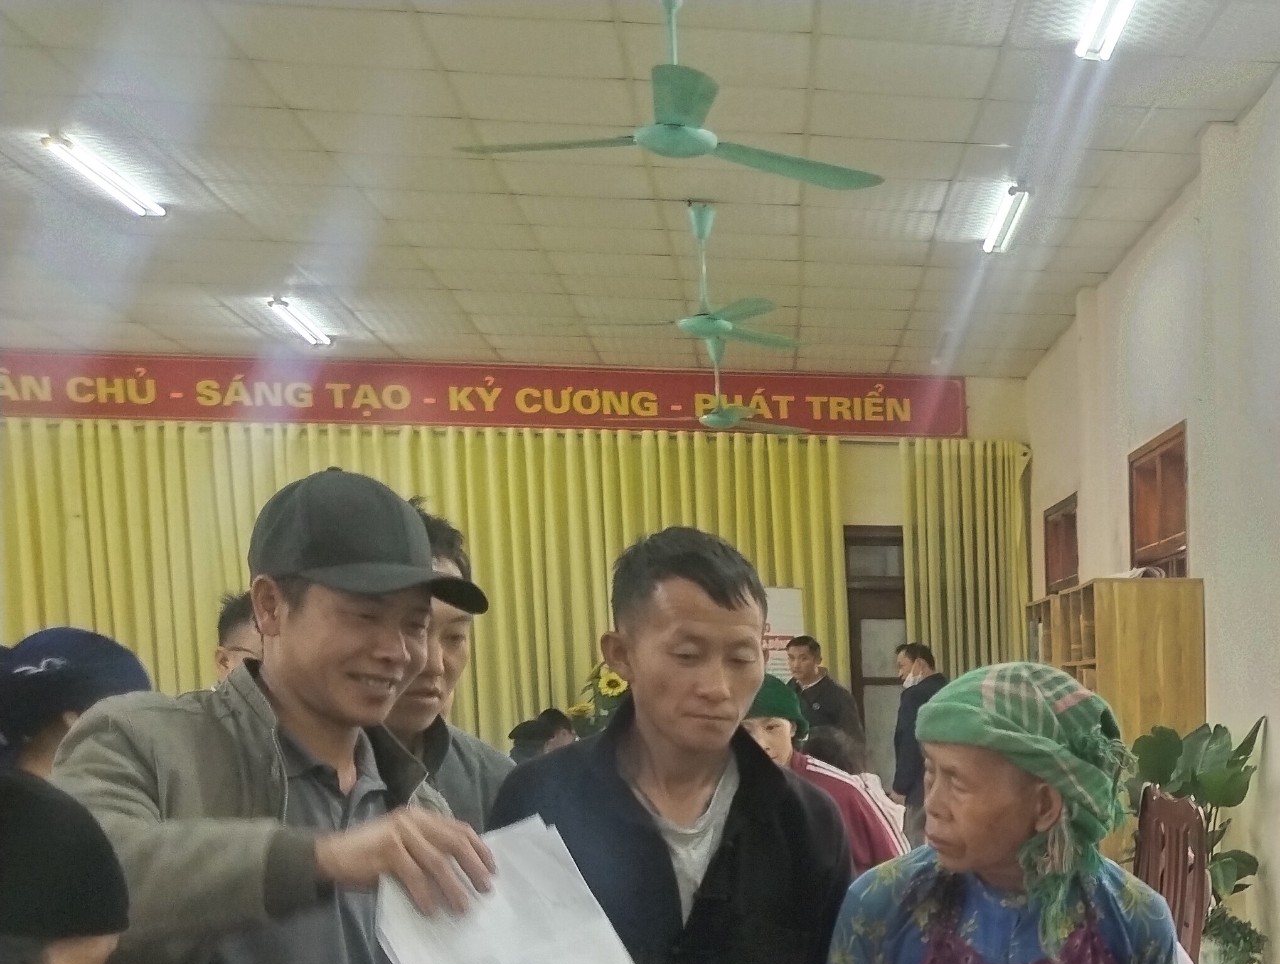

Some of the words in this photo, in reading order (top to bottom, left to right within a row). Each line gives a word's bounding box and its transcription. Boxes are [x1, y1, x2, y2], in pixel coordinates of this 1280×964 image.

[66, 367, 156, 405] CHỦ
[196, 374, 314, 408] SÁNG
[325, 383, 412, 417] TẠO
[448, 375, 502, 412] KỶ
[515, 386, 659, 416] CƯƠNG
[806, 383, 911, 422] TRIỂN
